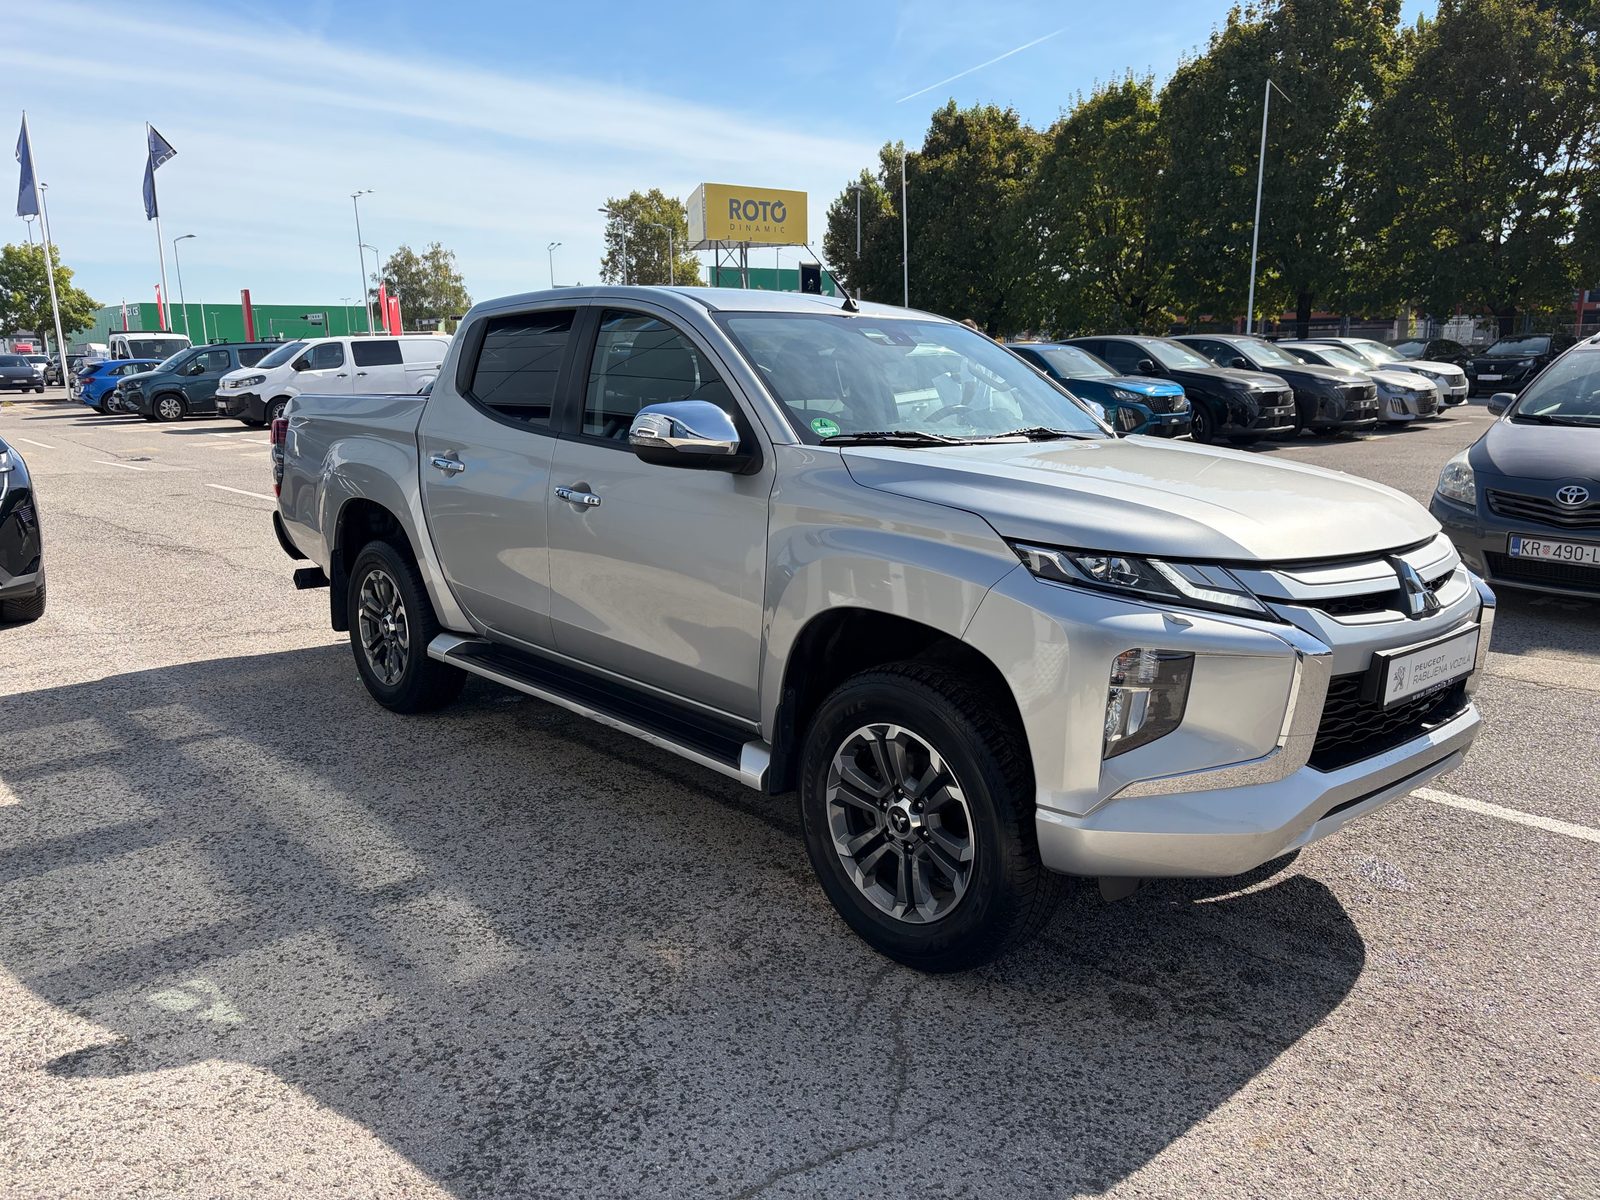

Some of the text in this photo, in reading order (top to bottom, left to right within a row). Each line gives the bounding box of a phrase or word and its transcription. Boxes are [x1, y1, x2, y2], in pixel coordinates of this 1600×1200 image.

[729, 198, 787, 223] ROTO
[729, 224, 785, 233] DINAMIC
[1521, 540, 1541, 556] KR
[1414, 655, 1446, 672] PEUGEOT
[1449, 655, 1471, 670] VOZILA
